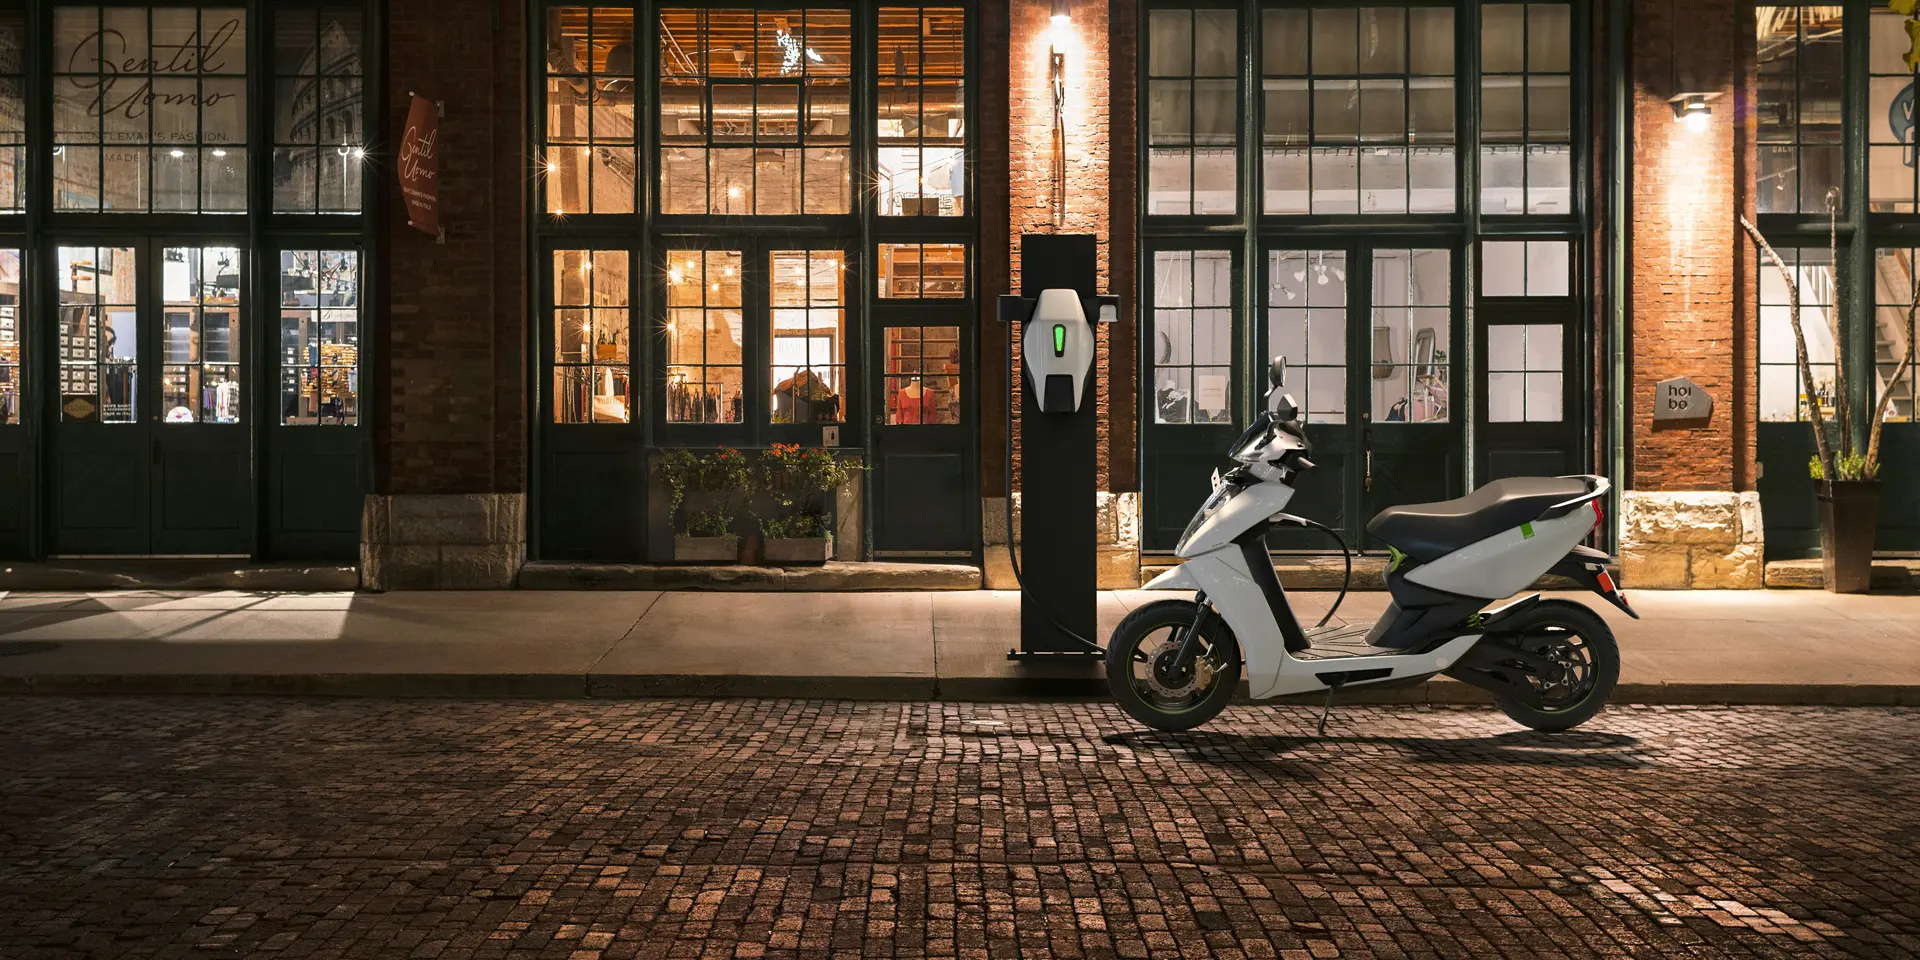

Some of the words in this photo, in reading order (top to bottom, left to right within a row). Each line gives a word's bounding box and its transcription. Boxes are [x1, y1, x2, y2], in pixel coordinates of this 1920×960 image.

[68, 18, 240, 89] Gentil
[86, 76, 236, 119] Uomo
[170, 131, 230, 141] FASION.
[401, 125, 437, 161] Gentil
[105, 153, 140, 163] MADE
[404, 158, 436, 182] Uomo
[1668, 385, 1692, 397] hoi
[1668, 398, 1688, 410] bo
